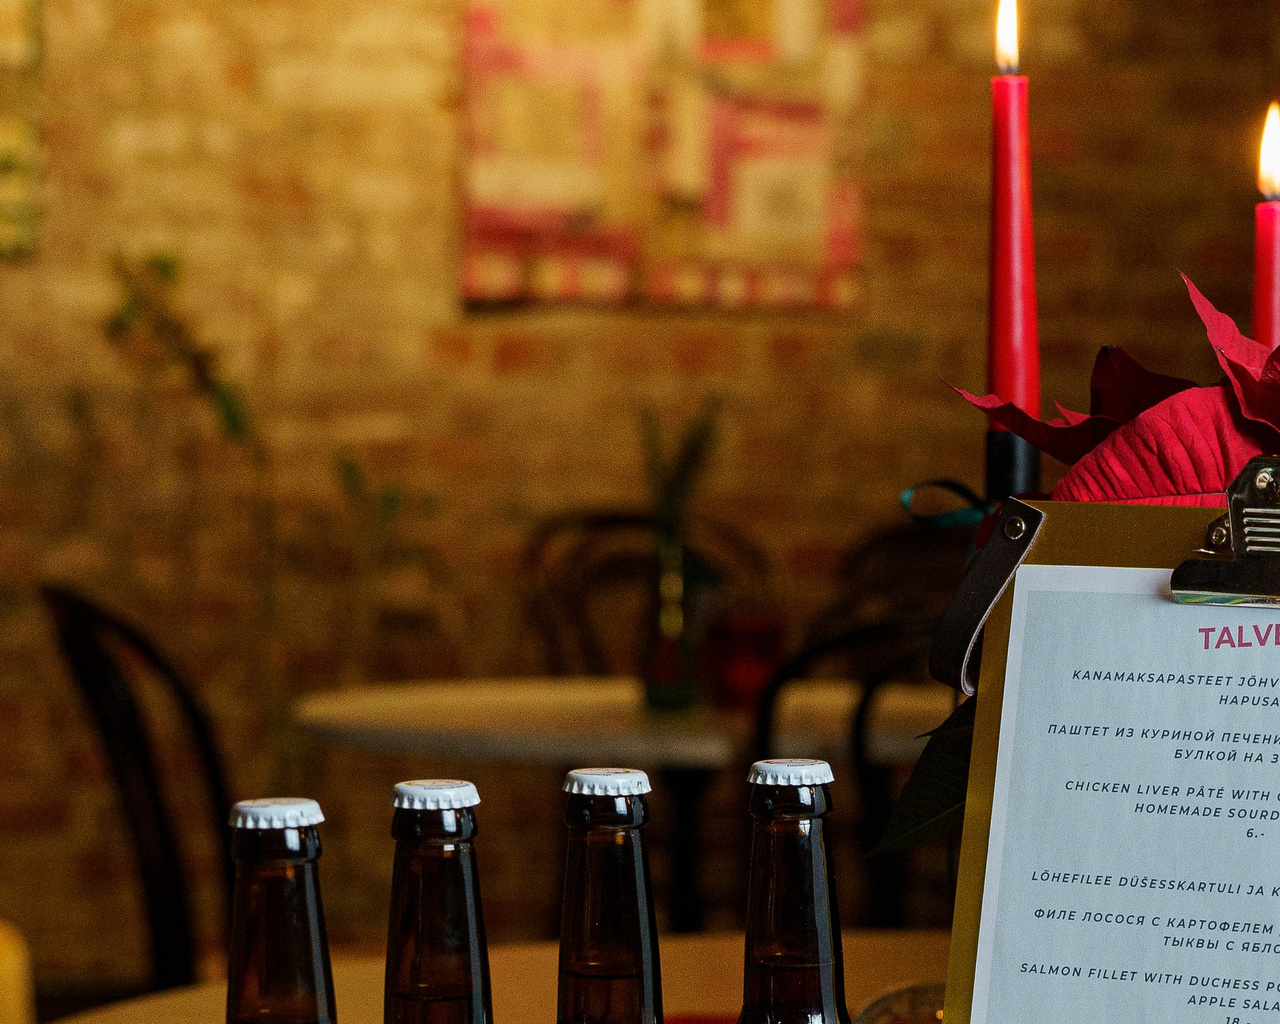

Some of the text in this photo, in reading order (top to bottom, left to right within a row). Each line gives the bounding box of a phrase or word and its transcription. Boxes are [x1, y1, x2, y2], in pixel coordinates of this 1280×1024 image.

[1072, 669, 1234, 687] KANAMAKSAPASTEET
[1047, 723, 1110, 737] ПАШТЕТ
[1114, 727, 1135, 738] ИЗ
[1140, 728, 1216, 742] КУРИНОЙ
[1173, 748, 1238, 762] БУЛКОЙ
[1243, 752, 1264, 763] НА
[1064, 780, 1131, 794] CHICKEN
[1136, 784, 1181, 797] LIVER
[1185, 785, 1225, 799] PÂTÉ
[1231, 789, 1271, 802] WITH
[1134, 802, 1223, 818] HOMEMADE
[1245, 827, 1265, 839] 6.-
[1031, 869, 1113, 886] LÕHEFILEE
[1118, 875, 1242, 895] DÜŠESSKARTULI
[1246, 884, 1265, 896] JA
[1033, 908, 1077, 921] ФИЛЕ
[1081, 911, 1146, 926] ЛОСОСЯ
[1166, 917, 1274, 935] КАРТОФЕЛЕМ
[1163, 935, 1220, 950] ТЫКВЫ
[1019, 962, 1083, 978] SALMON
[1087, 967, 1139, 982] FILLET
[1144, 972, 1183, 985] WITH
[1188, 975, 1260, 991] DUCHESS
[1186, 994, 1237, 1009] APPLE
